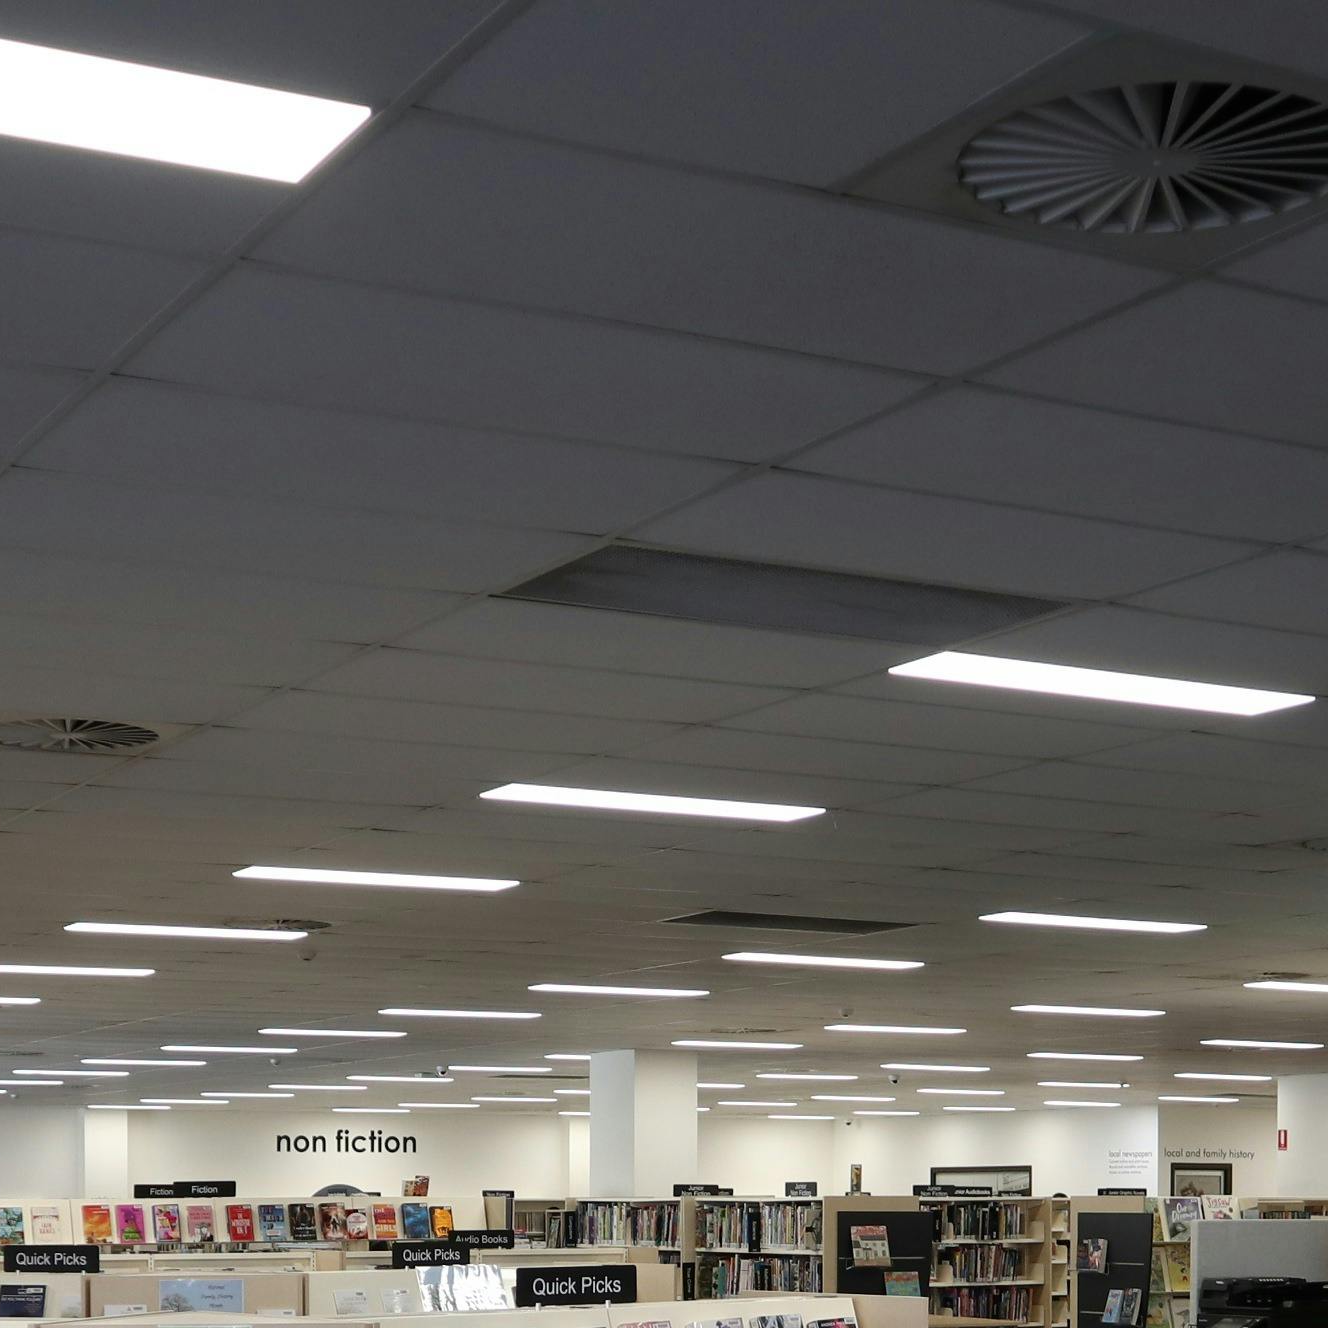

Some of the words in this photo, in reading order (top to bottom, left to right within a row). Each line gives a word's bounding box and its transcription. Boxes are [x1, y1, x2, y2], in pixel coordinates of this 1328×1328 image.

[276, 1134, 326, 1152] non
[336, 1130, 416, 1153] fiction
[1164, 1149, 1183, 1157] local
[1203, 1149, 1226, 1159] family
[1229, 1150, 1254, 1160] history
[482, 1235, 508, 1244] Books
[16, 1253, 50, 1265] Quick
[55, 1253, 87, 1265] Picks
[403, 1249, 431, 1261] Quick
[435, 1249, 460, 1260] Picks
[532, 1277, 576, 1296] Quick
[582, 1276, 621, 1294] Picks
